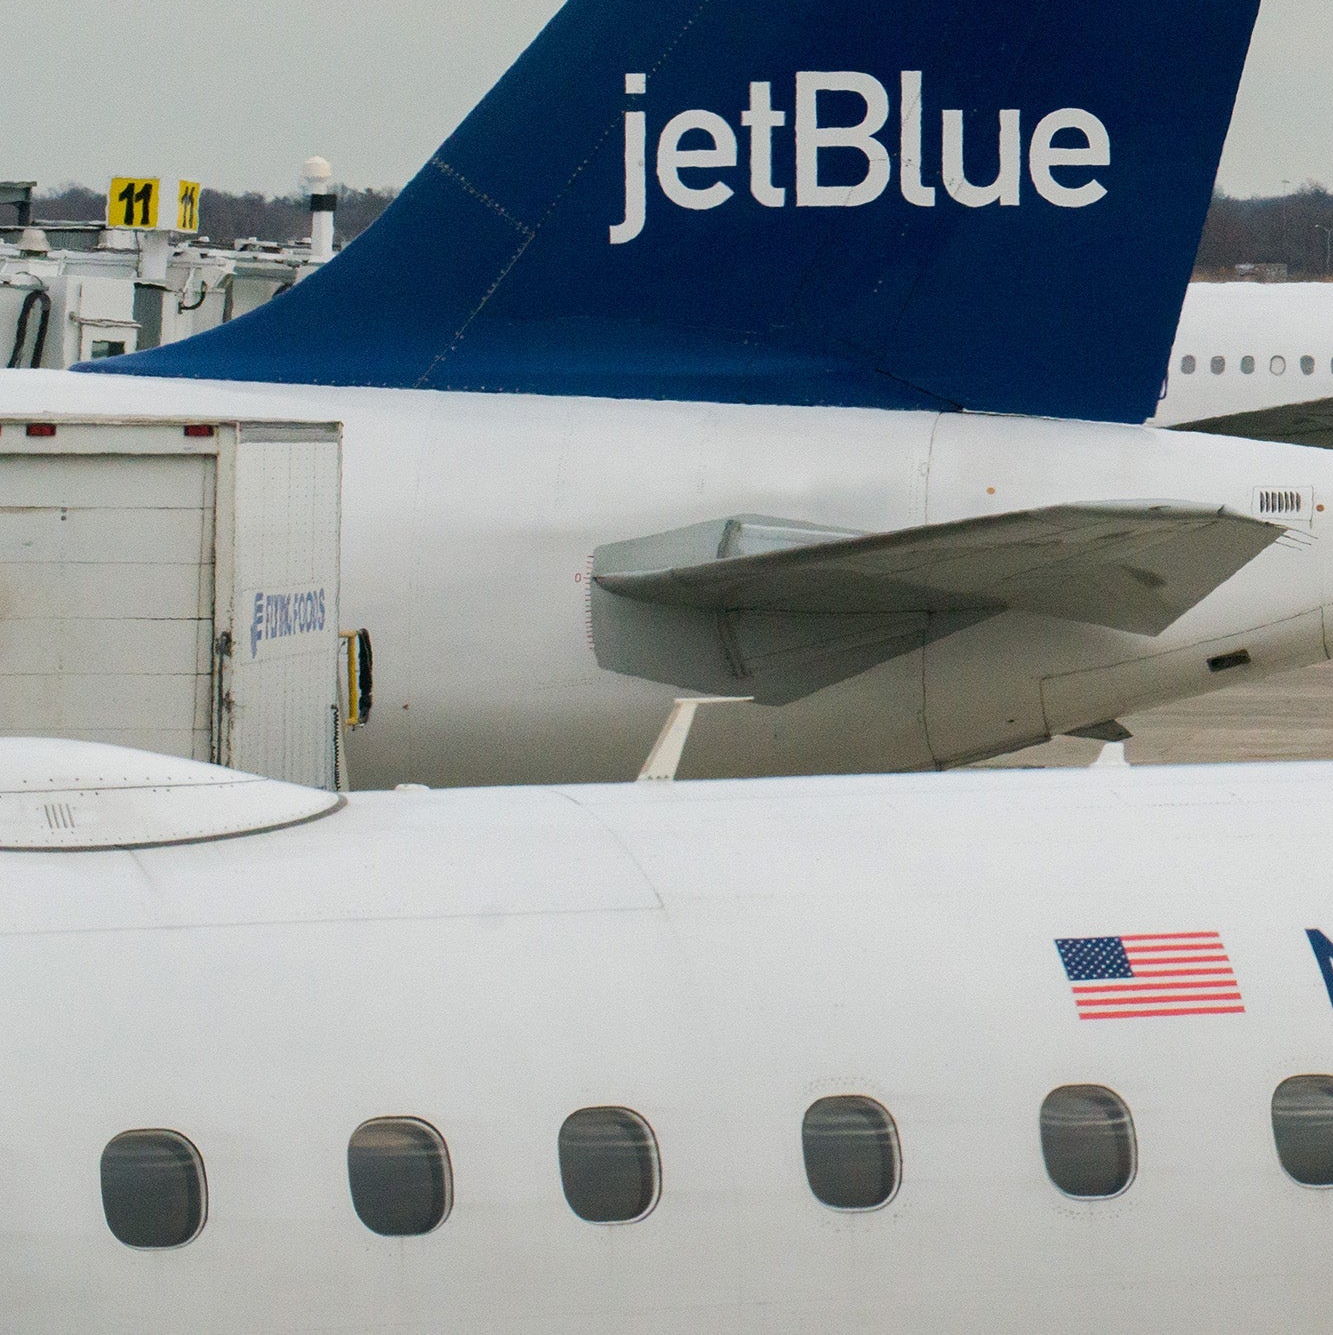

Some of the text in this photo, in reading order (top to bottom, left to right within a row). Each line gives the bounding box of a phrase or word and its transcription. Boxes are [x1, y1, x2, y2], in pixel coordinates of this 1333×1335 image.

[609, 70, 1110, 244] jetBlue
[118, 182, 153, 225] 11
[181, 186, 195, 230] 11
